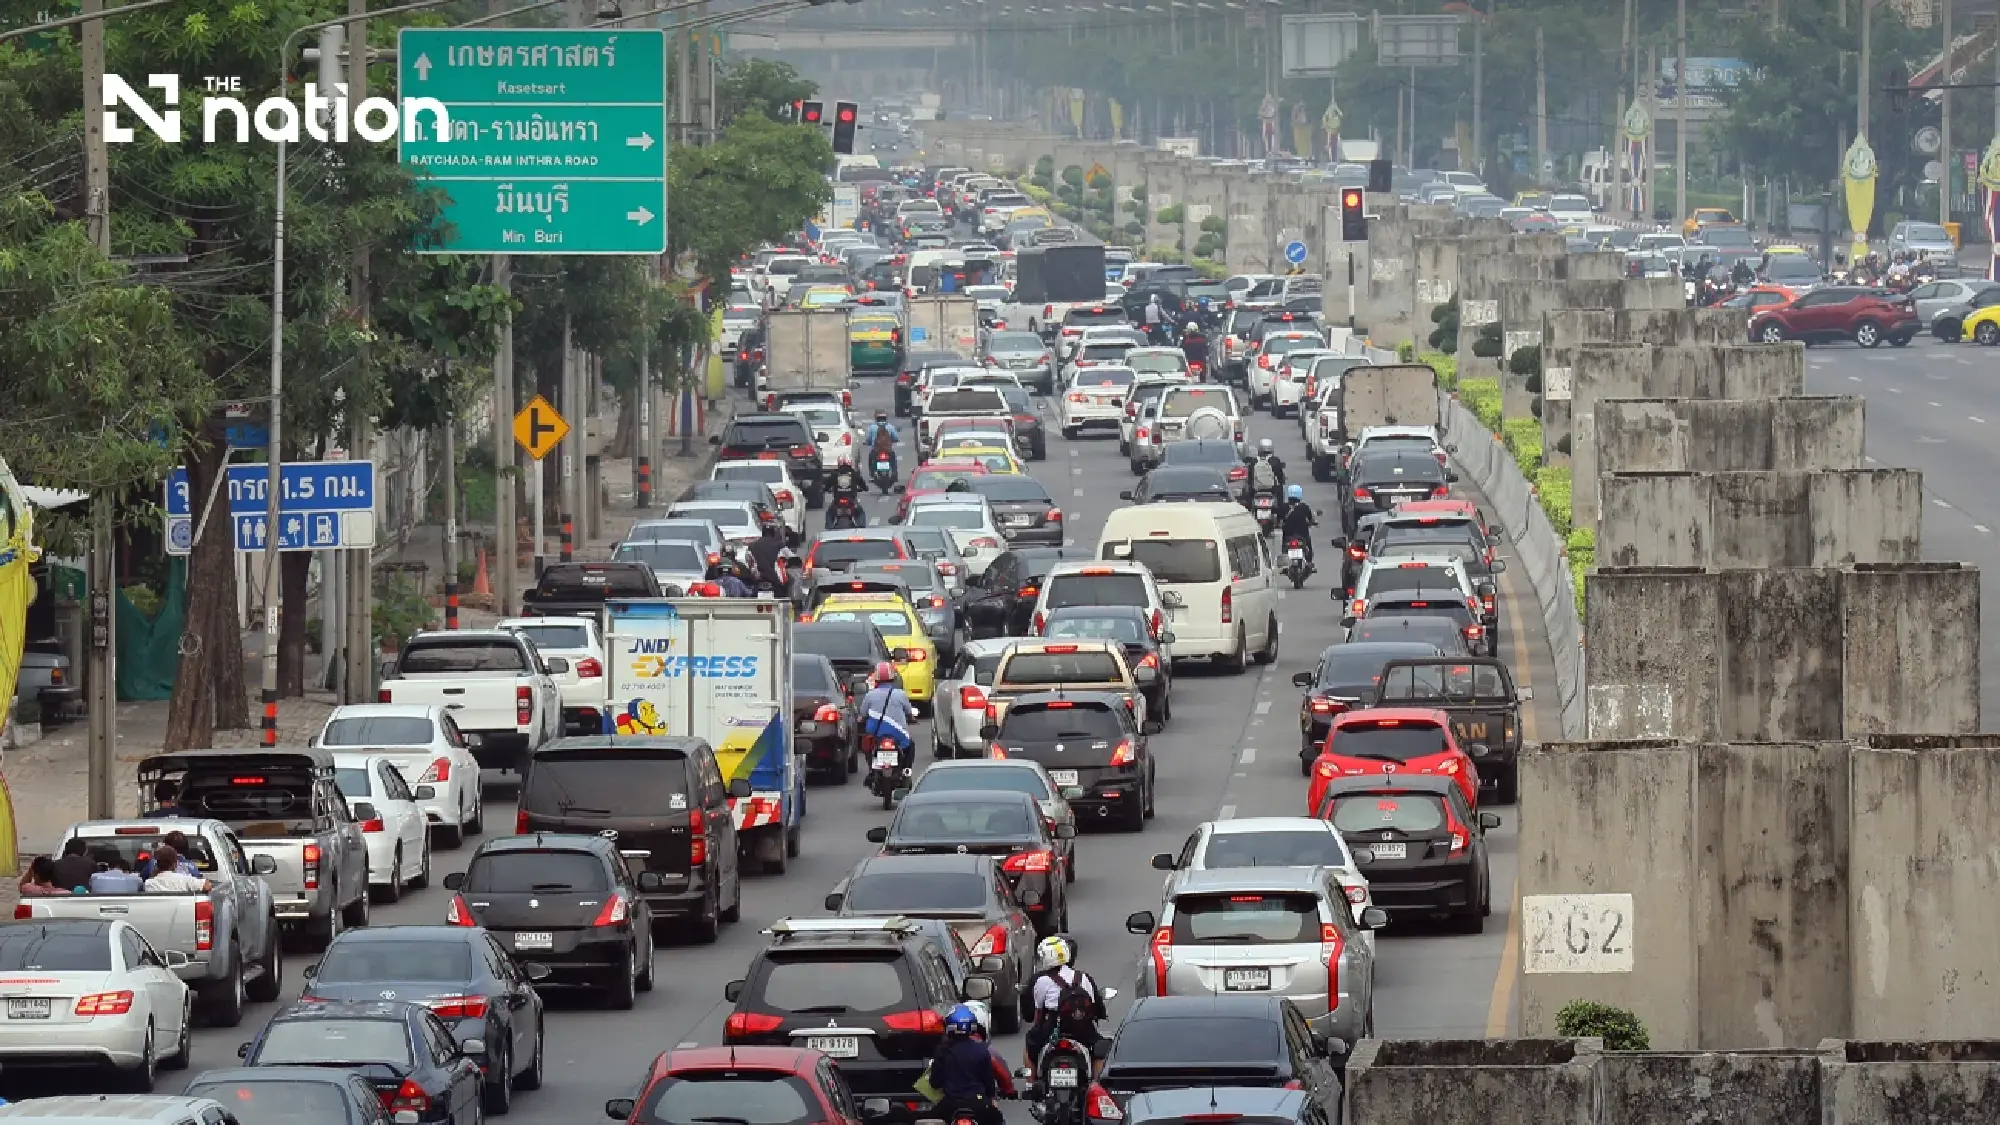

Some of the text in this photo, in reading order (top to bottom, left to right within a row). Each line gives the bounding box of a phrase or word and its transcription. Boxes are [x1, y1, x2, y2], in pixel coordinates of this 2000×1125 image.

[448, 36, 618, 67] เกษตรศาสตร์
[497, 81, 566, 94] Kasetsart
[411, 154, 599, 166] RATCHADA-RAM INTHRA ROAD
[496, 182, 570, 223] มีนบุรี
[502, 229, 563, 243] Min Buri
[325, 475, 366, 498] กม.
[631, 656, 758, 677] EXPRESS
[1531, 909, 1624, 954] 262
